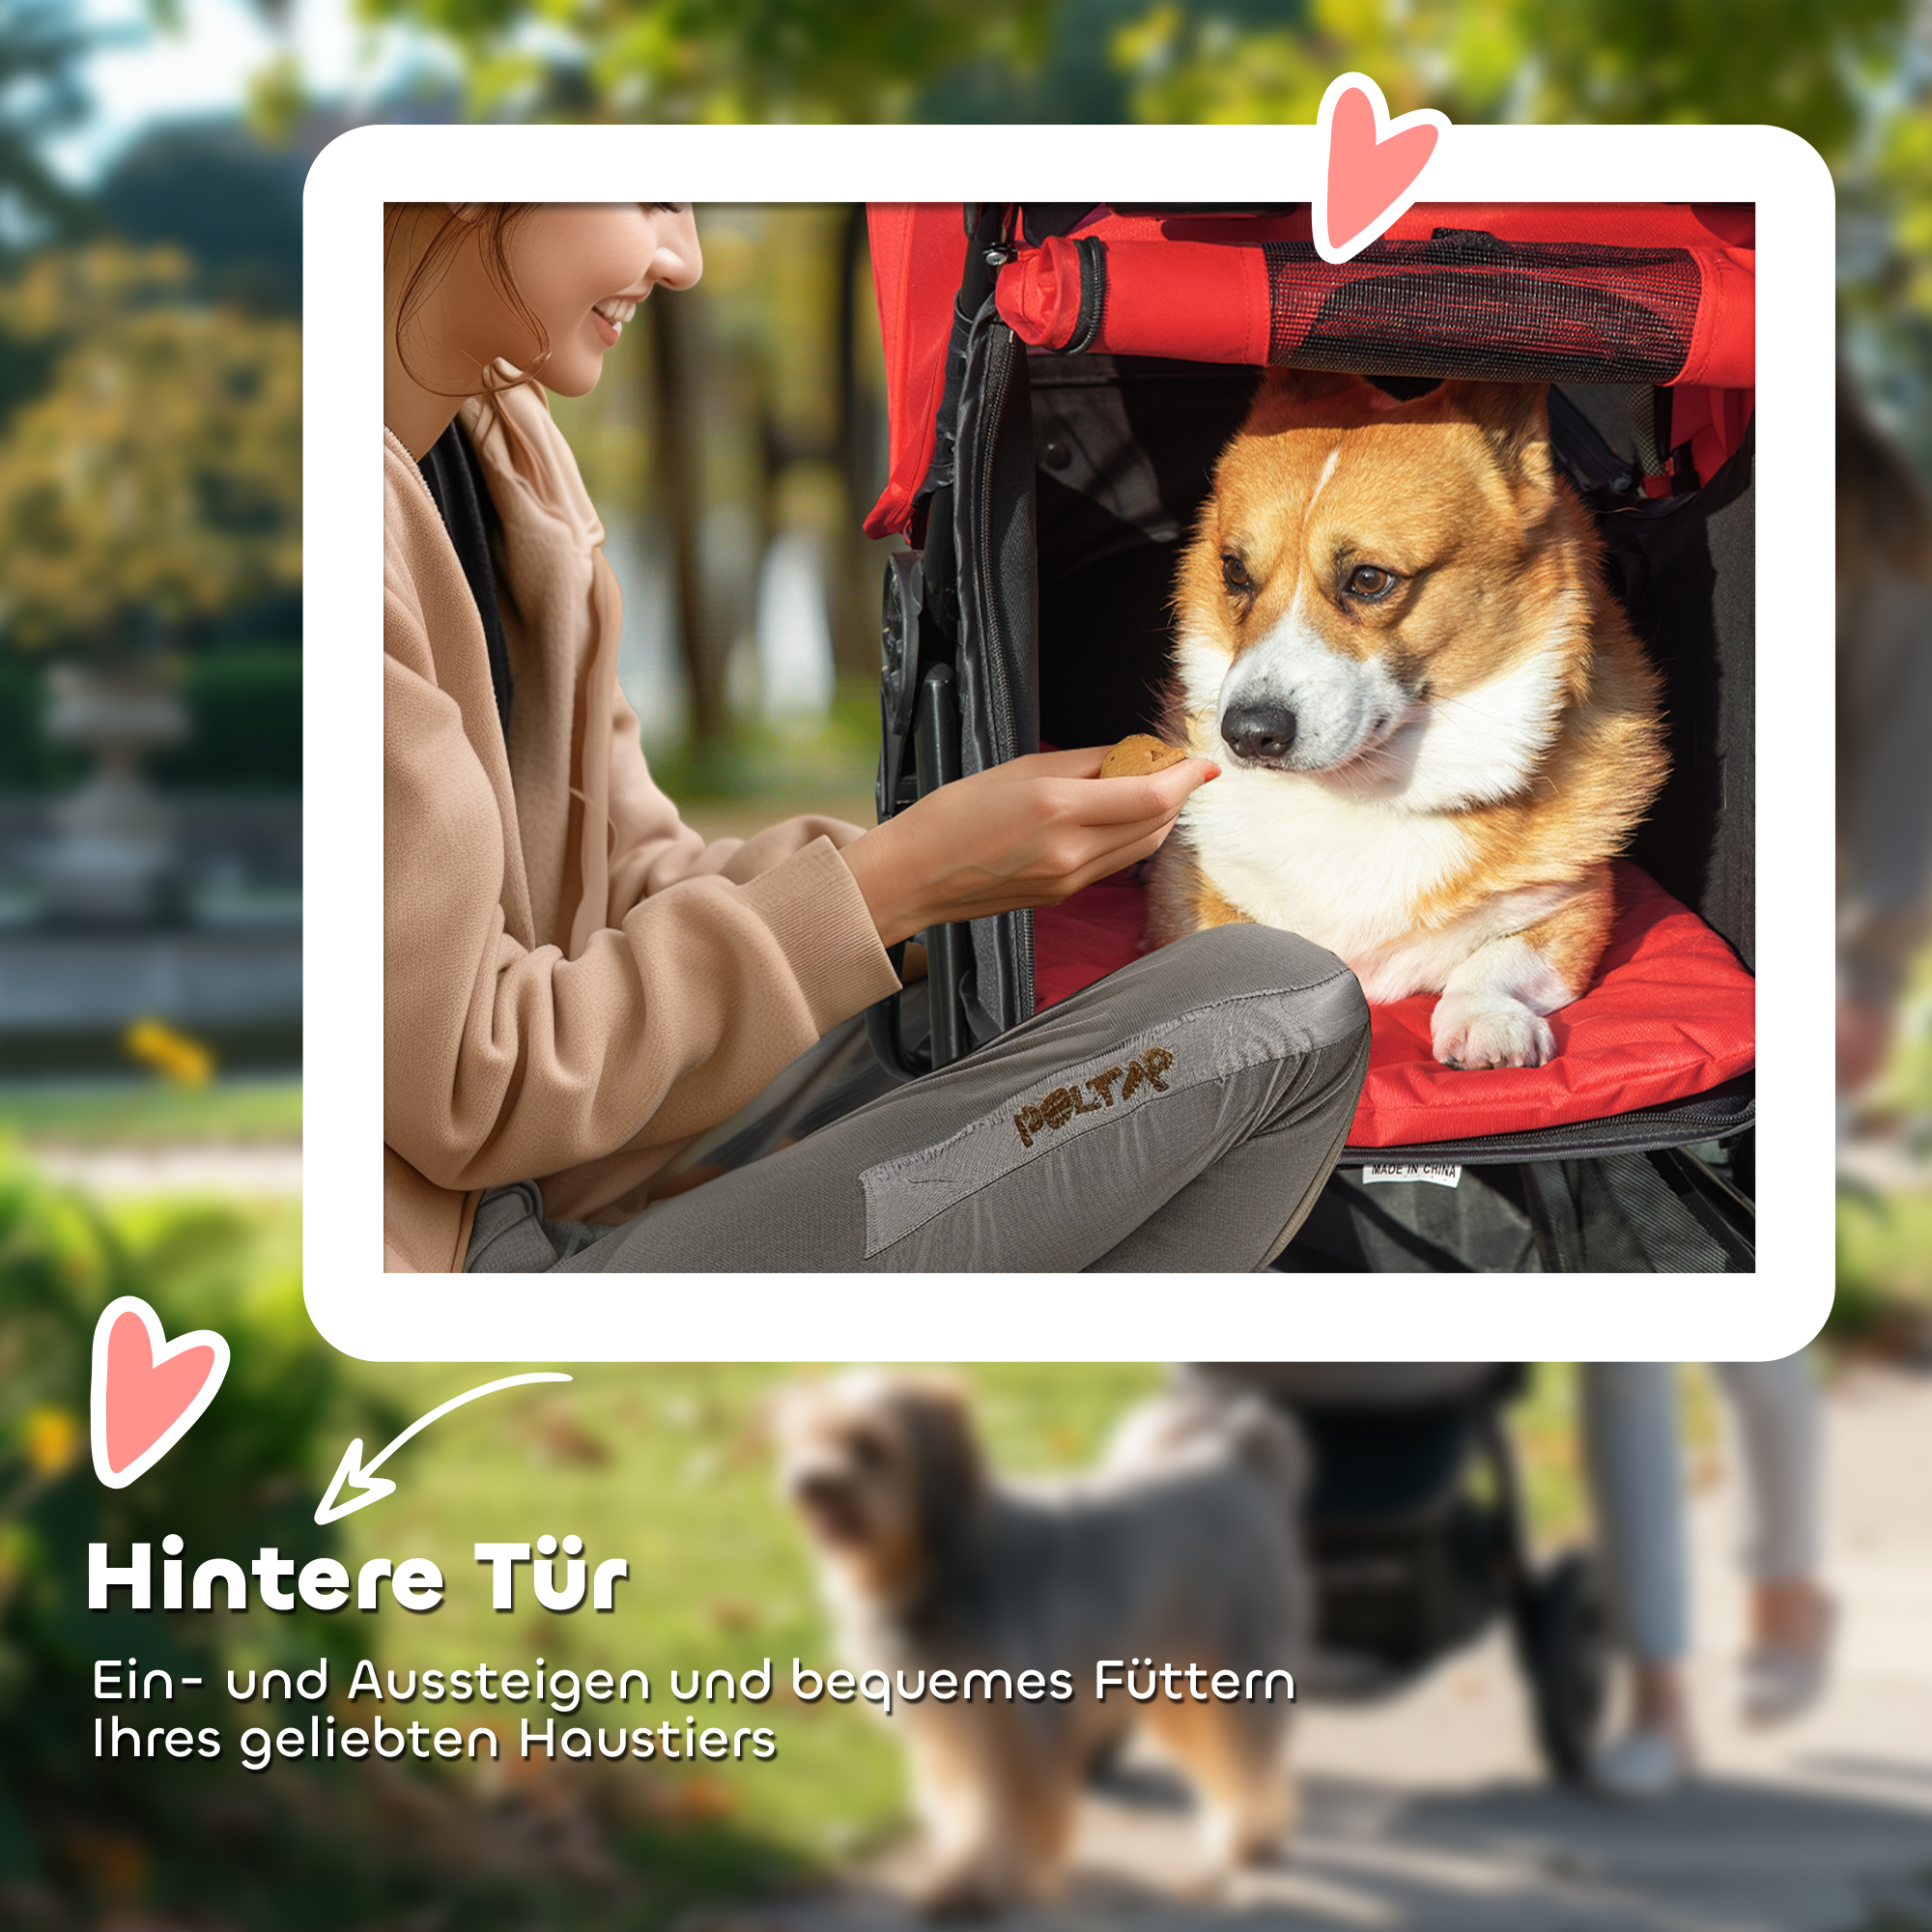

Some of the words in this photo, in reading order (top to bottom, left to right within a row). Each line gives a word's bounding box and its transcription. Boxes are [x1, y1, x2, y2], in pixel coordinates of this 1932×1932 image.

[1372, 1164, 1403, 1176] MADE
[1407, 1164, 1419, 1175] IN
[1423, 1164, 1456, 1179] CHINA
